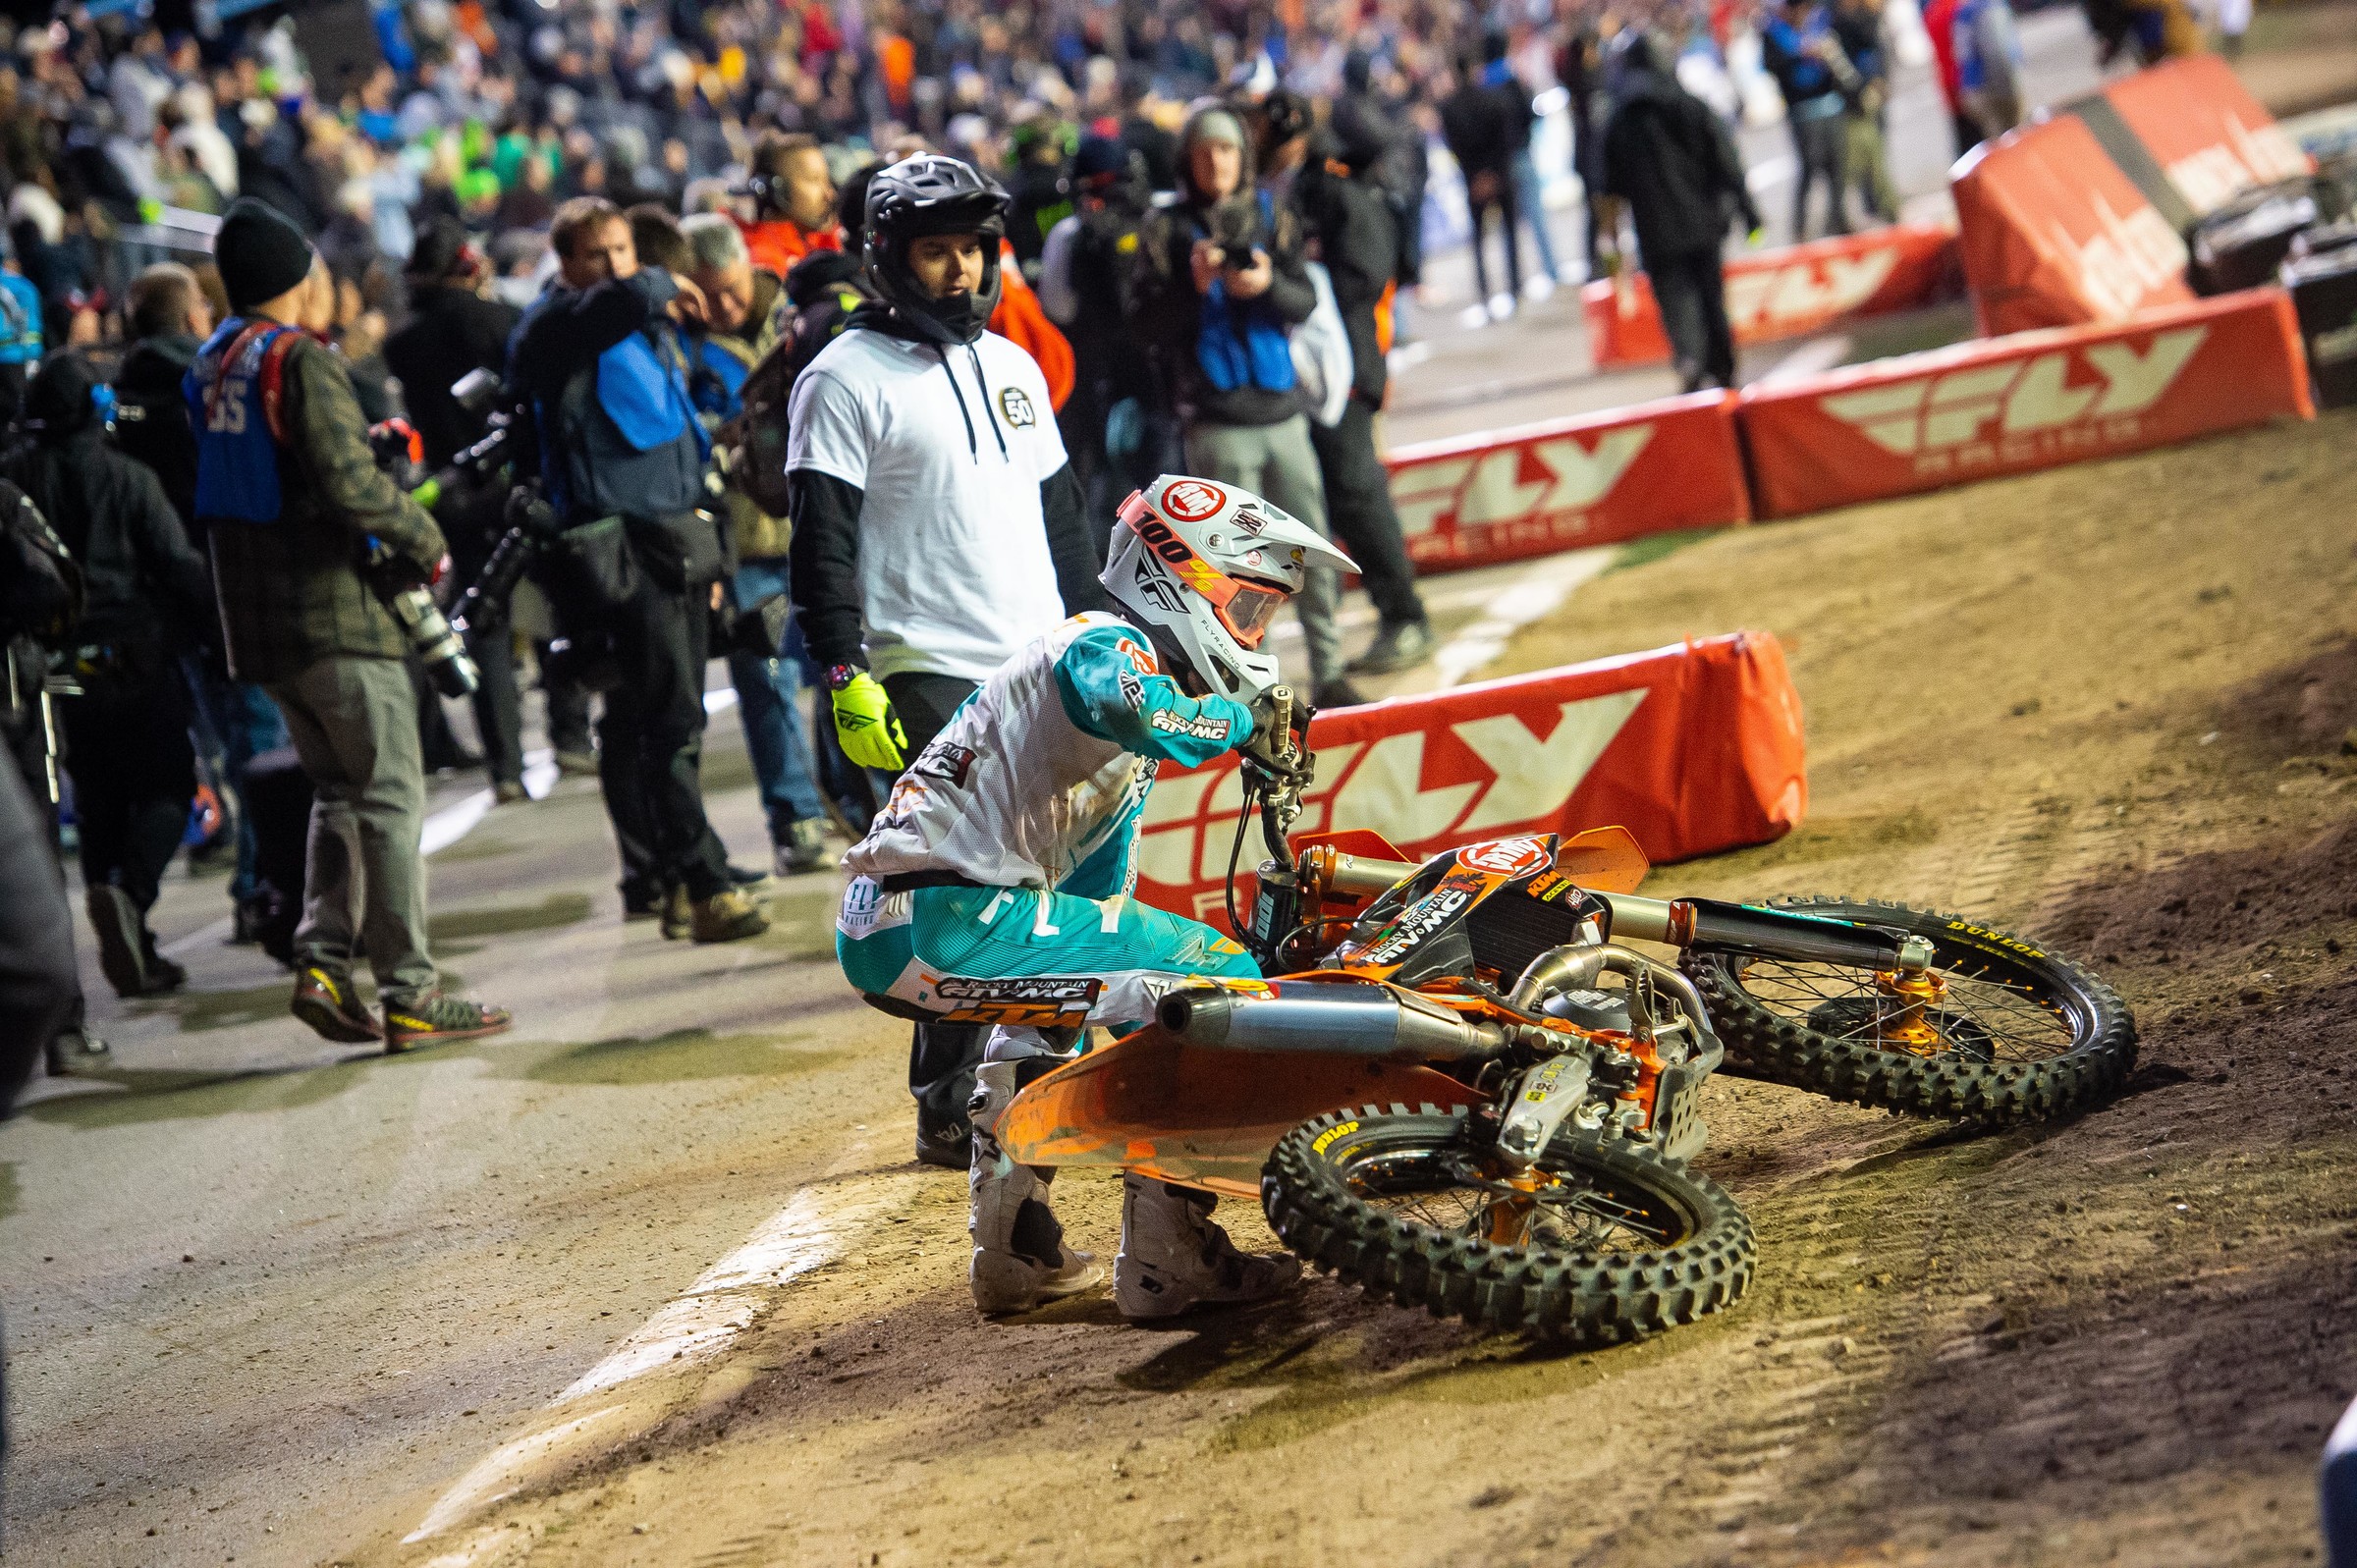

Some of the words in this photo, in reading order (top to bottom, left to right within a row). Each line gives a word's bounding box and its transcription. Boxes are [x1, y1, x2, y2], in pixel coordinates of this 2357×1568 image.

[1824, 325, 2210, 455] FLY
[1132, 510, 1224, 593] 100%
[1526, 870, 1563, 898] KTM
[1372, 931, 1405, 955] ROCKY
[1401, 888, 1453, 934] MOUNTAIN
[1945, 920, 2049, 959] DUNLOP
[966, 980, 1013, 989] ROCKY
[1014, 980, 1090, 989] MOUNTAIN
